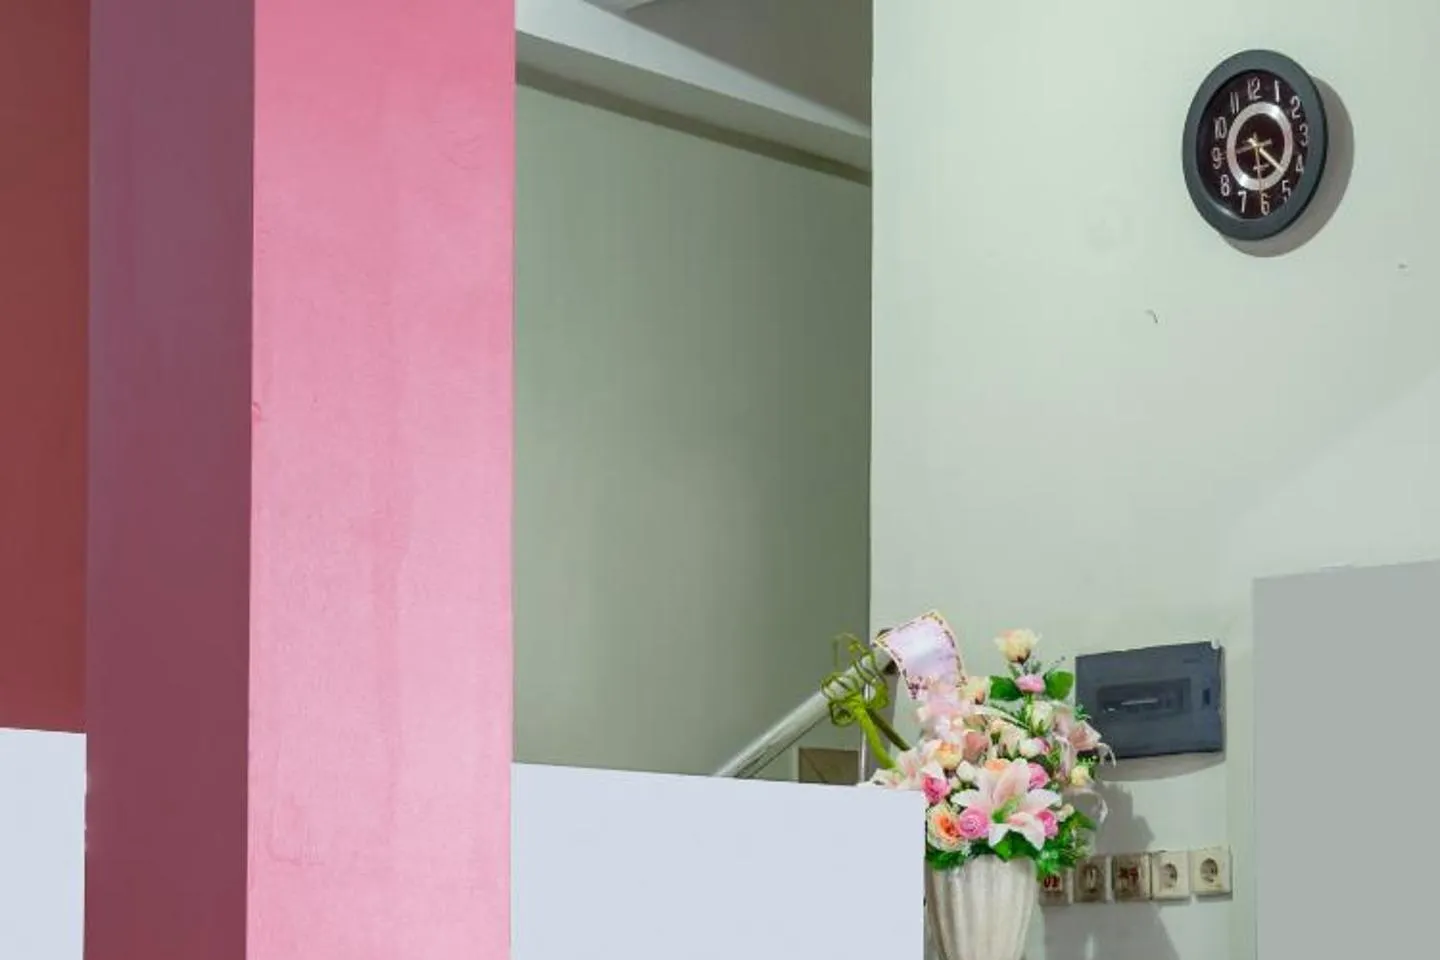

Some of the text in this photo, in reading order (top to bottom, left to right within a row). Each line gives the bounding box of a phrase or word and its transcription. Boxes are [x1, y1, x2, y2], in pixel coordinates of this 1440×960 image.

[1247, 77, 1261, 100] 12
[1274, 80, 1280, 102] 1
[1230, 92, 1240, 114] 11
[1290, 95, 1301, 118] 2
[1214, 116, 1228, 139] 10
[1299, 124, 1309, 146] 3
[1211, 147, 1222, 170] 9
[1295, 155, 1304, 175] 4
[1220, 174, 1231, 197] 8
[1282, 180, 1291, 203] 5
[1238, 190, 1247, 213] 7
[1260, 193, 1270, 215] 6
